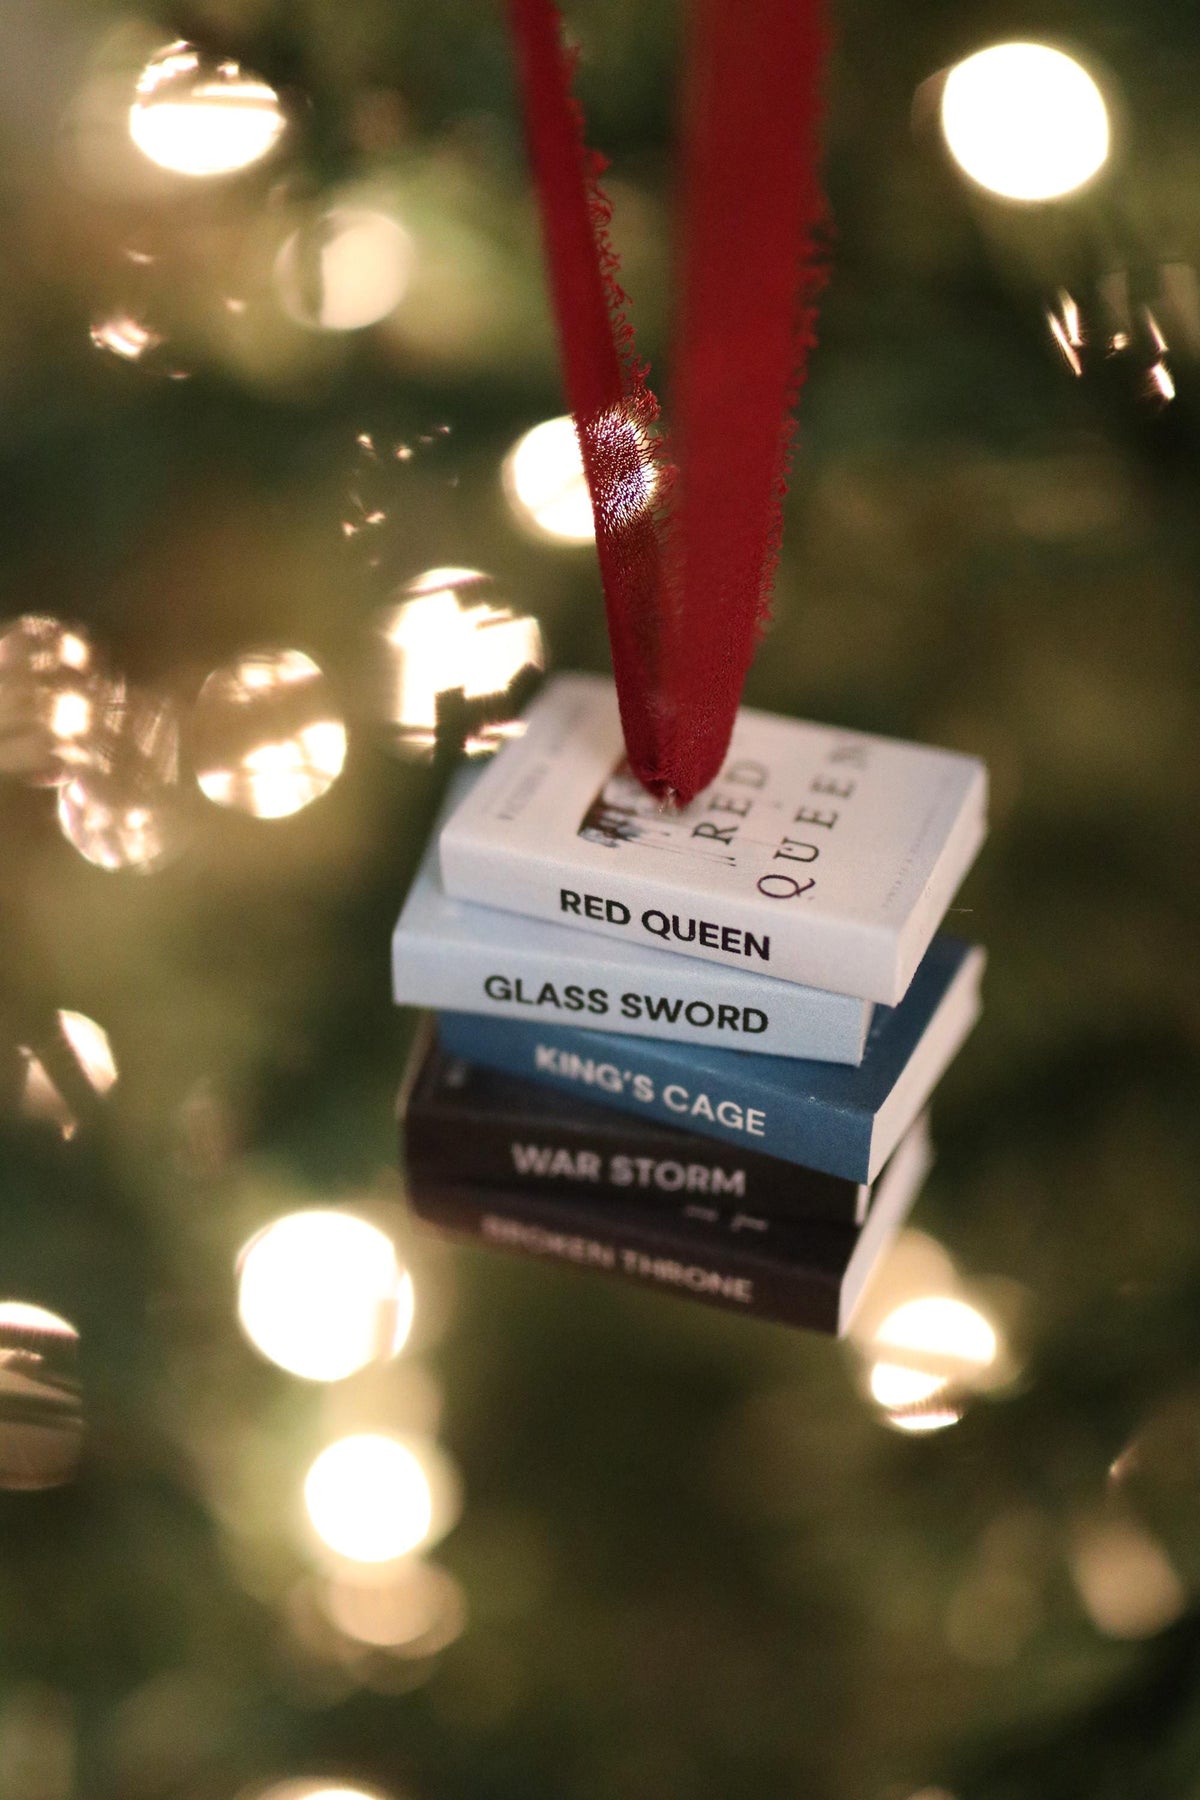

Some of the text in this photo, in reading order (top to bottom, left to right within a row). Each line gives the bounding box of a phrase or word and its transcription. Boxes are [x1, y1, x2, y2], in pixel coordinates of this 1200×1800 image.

[691, 758, 770, 846] RED
[757, 742, 871, 900] QUEEN
[560, 888, 771, 961] RED QUEEN
[484, 975, 769, 1033] GLASS SWORD
[535, 1045, 767, 1136] KING'S CAGE
[511, 1143, 746, 1196] WAR STORM
[624, 1249, 752, 1303] THRONE
